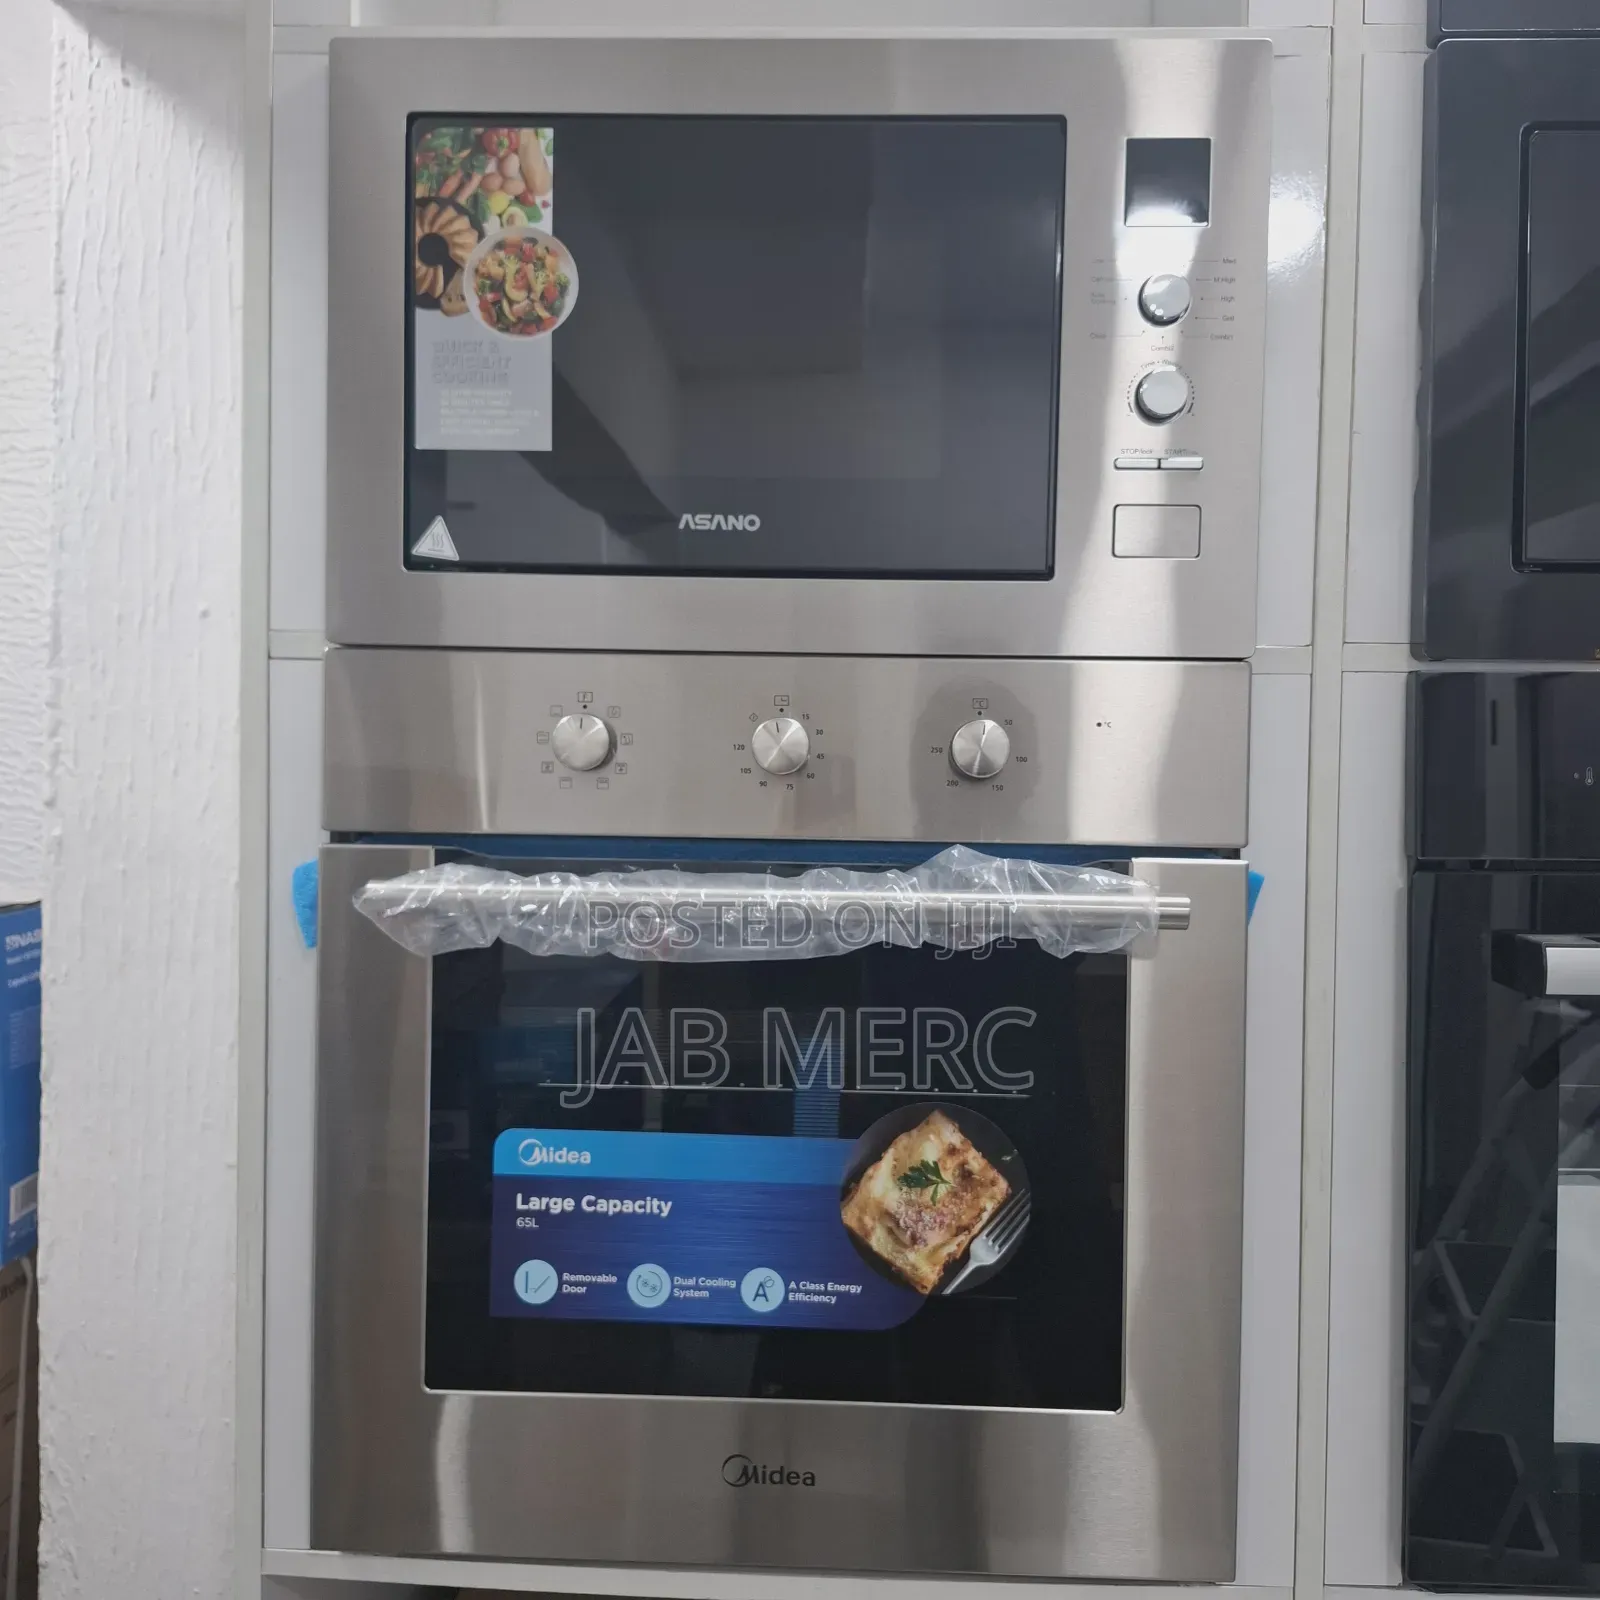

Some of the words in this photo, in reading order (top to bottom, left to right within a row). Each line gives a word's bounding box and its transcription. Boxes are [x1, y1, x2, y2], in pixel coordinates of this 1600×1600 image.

[678, 513, 761, 532] ASANO
[518, 1138, 592, 1166] Midea
[515, 1192, 575, 1215] Large
[581, 1194, 673, 1218] Capacity
[516, 1217, 540, 1229] 65L
[562, 1272, 618, 1284] Removable
[673, 1276, 696, 1286] Dual
[699, 1277, 737, 1288] Cooling
[562, 1284, 588, 1294] Door
[673, 1287, 710, 1298] System
[788, 1281, 797, 1289] A
[800, 1281, 825, 1291] Class
[827, 1282, 863, 1294] Energy
[788, 1292, 837, 1304] Efficiency
[722, 1454, 816, 1488] Midea
